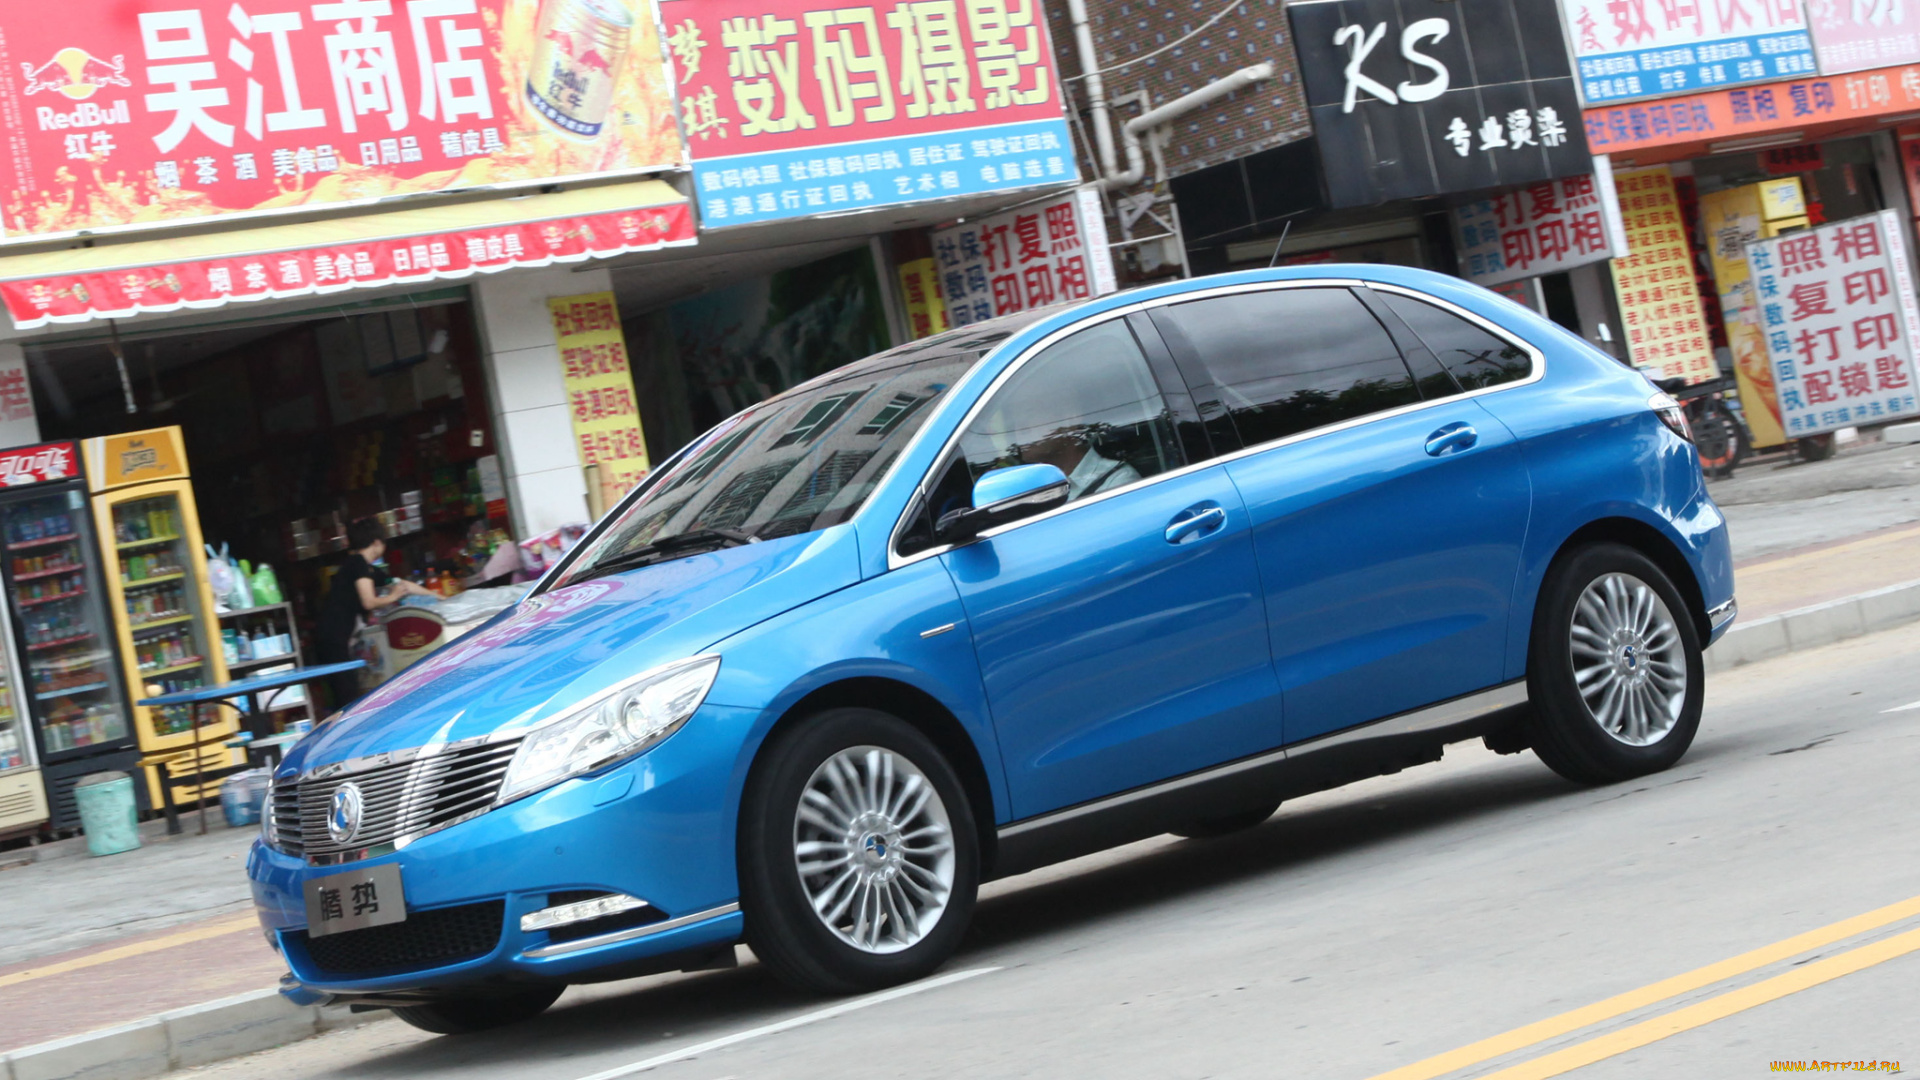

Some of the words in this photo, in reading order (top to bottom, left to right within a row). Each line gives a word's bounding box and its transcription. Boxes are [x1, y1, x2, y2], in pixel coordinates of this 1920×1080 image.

[138, 0, 495, 154] 吴江商店
[667, 18, 730, 141] 梦琪
[720, 0, 1049, 137] 数码摄影
[1333, 17, 1451, 114] KS
[36, 99, 131, 131] RedBull
[1584, 100, 1715, 147] 社保数码回执
[1728, 89, 1778, 125] 照相
[1789, 81, 1835, 117] 复印
[1845, 75, 1891, 110] 打印
[64, 130, 117, 159] 红牛
[154, 160, 181, 188] 烟
[193, 156, 219, 184] 茶
[233, 152, 258, 180] 酒
[272, 144, 338, 177] 美食品
[360, 136, 423, 166] 日用品
[441, 127, 505, 158] 精皮具
[700, 163, 780, 192] 数码快照
[788, 149, 902, 182] 社保数码回执
[909, 142, 965, 167] 居住证
[971, 131, 1062, 159] 驾驶证回执
[708, 180, 873, 219] 港澳通行证回执
[894, 170, 960, 195] 艺术相
[981, 156, 1065, 184] 电脑选景
[243, 262, 267, 289] 茶
[279, 259, 304, 284] 酒
[314, 251, 375, 281] 美食品
[393, 242, 451, 271] 日用品
[466, 233, 526, 263] 精皮具
[1778, 221, 1882, 278] 照相
[1787, 267, 1890, 322] 复印
[1795, 312, 1900, 366] 打印
[1803, 354, 1909, 406] 配锁匙
[1789, 409, 1818, 431] 传真
[1822, 405, 1850, 427] 扫描
[1887, 394, 1916, 414] 相片
